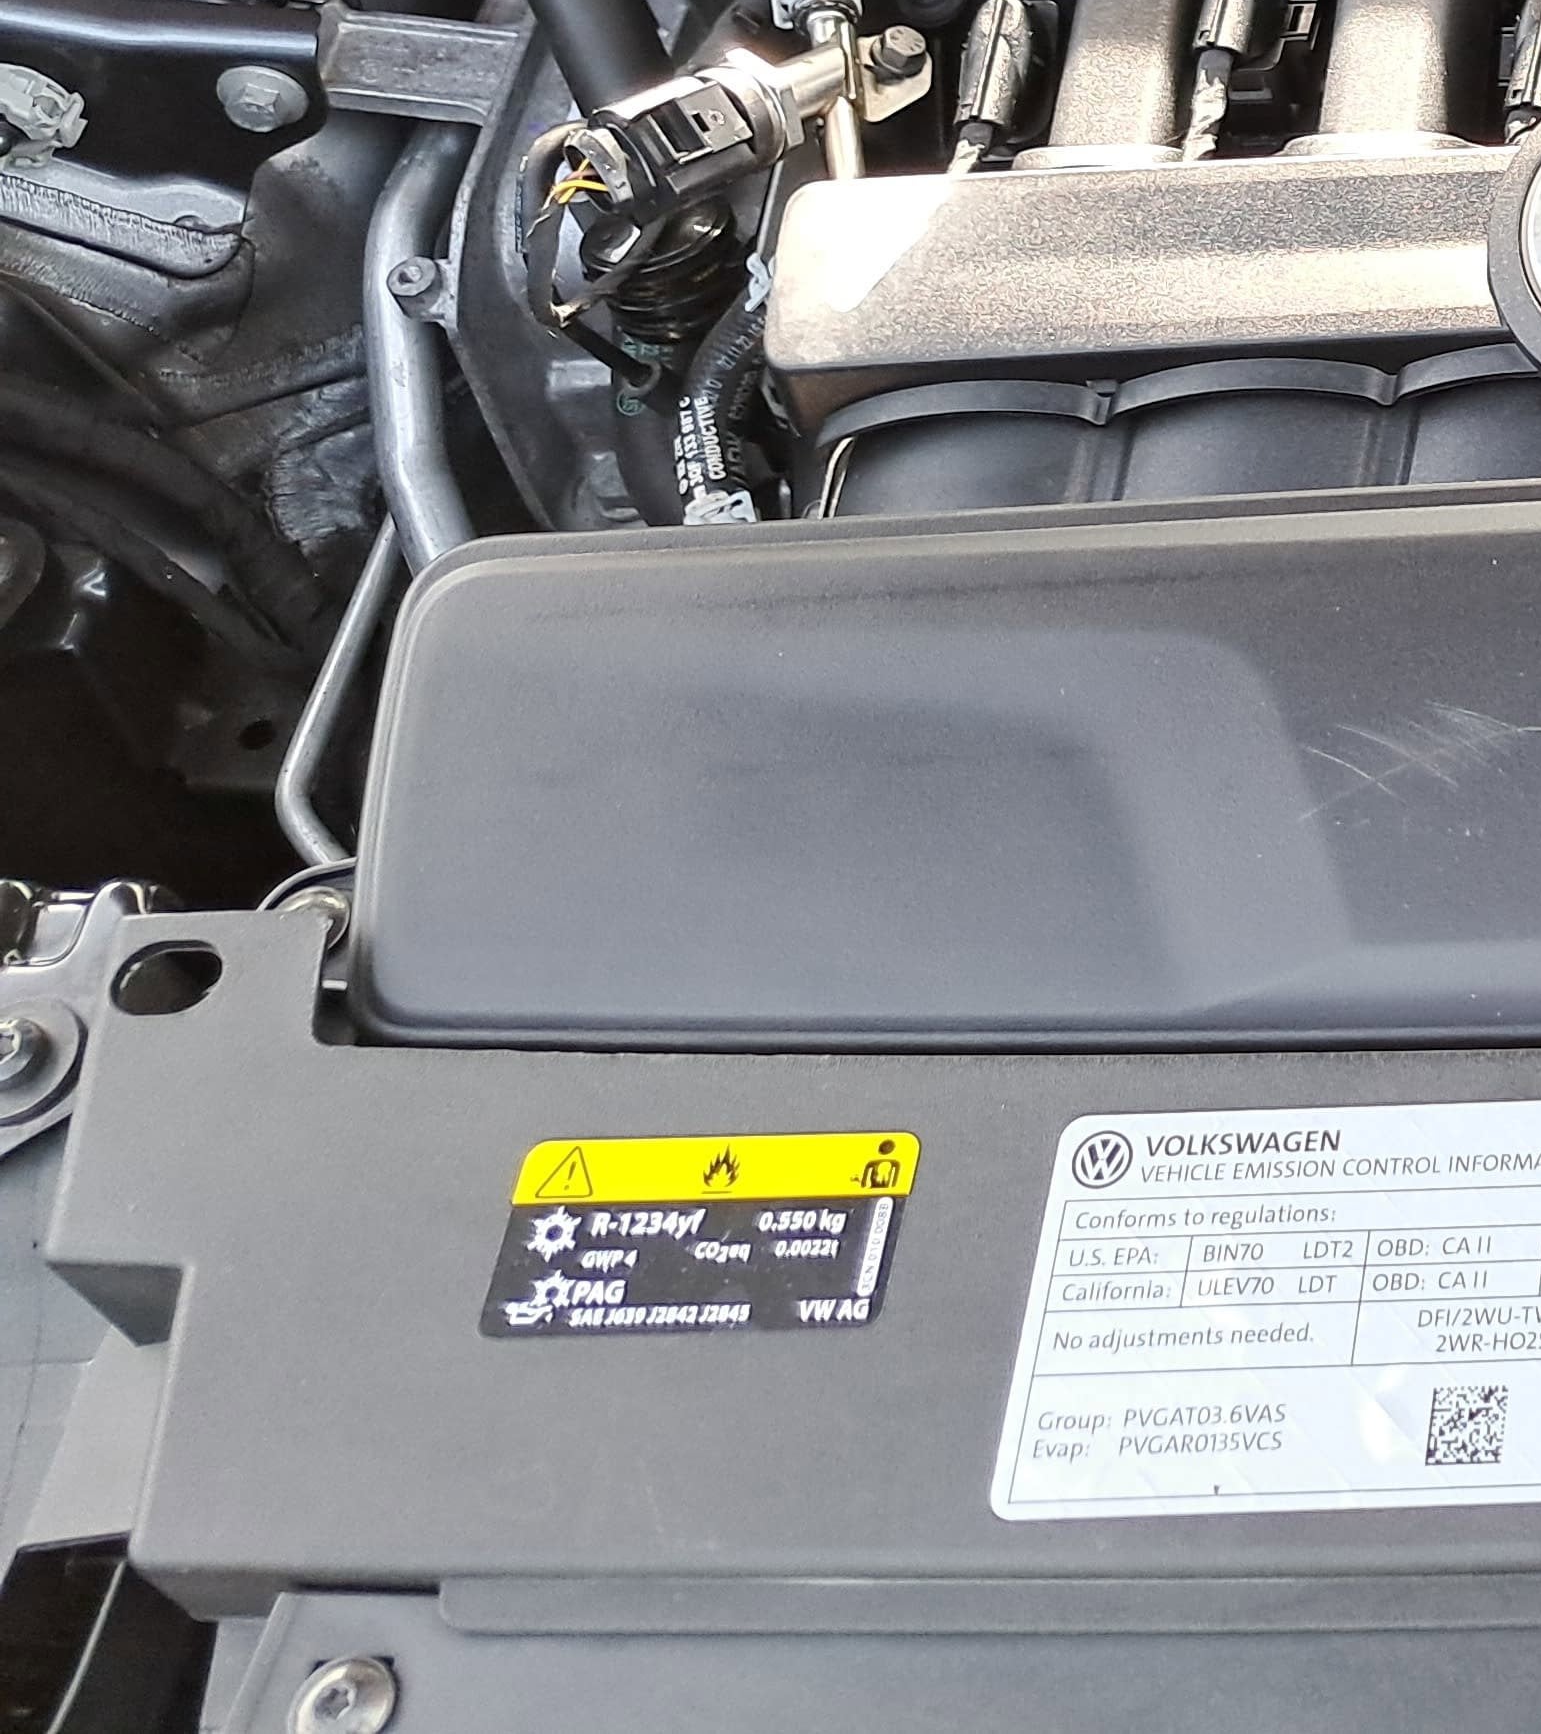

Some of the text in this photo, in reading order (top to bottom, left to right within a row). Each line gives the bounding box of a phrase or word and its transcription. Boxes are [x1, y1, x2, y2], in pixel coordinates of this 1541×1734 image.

[694, 396, 727, 481] CONDUCTIVE
[1145, 1129, 1341, 1158] VOLKSWAGEN
[1141, 1162, 1227, 1184] VEHICLE
[1232, 1158, 1336, 1181] EMISSION
[1342, 1155, 1441, 1177] CONTROL
[591, 1208, 708, 1240] R-1234yf
[758, 1209, 846, 1234] 0.550 kg
[1075, 1203, 1337, 1230] Conforms to regulations:
[1069, 1245, 1159, 1267] U.S. EPA:
[1203, 1242, 1264, 1263] BIN70
[1303, 1239, 1354, 1260] LDT2
[1377, 1235, 1492, 1258] OBD: CA II
[572, 1280, 626, 1305] PAG
[1061, 1279, 1172, 1302] California:
[1197, 1276, 1275, 1297] ULEV70
[1297, 1274, 1339, 1295] LDT
[1372, 1269, 1488, 1293] OBD: CA II
[799, 1299, 870, 1322] VW AG
[1052, 1321, 1315, 1355] No adjustments needed.
[1037, 1411, 1113, 1434] Group:
[1032, 1433, 1095, 1461] Evap:
